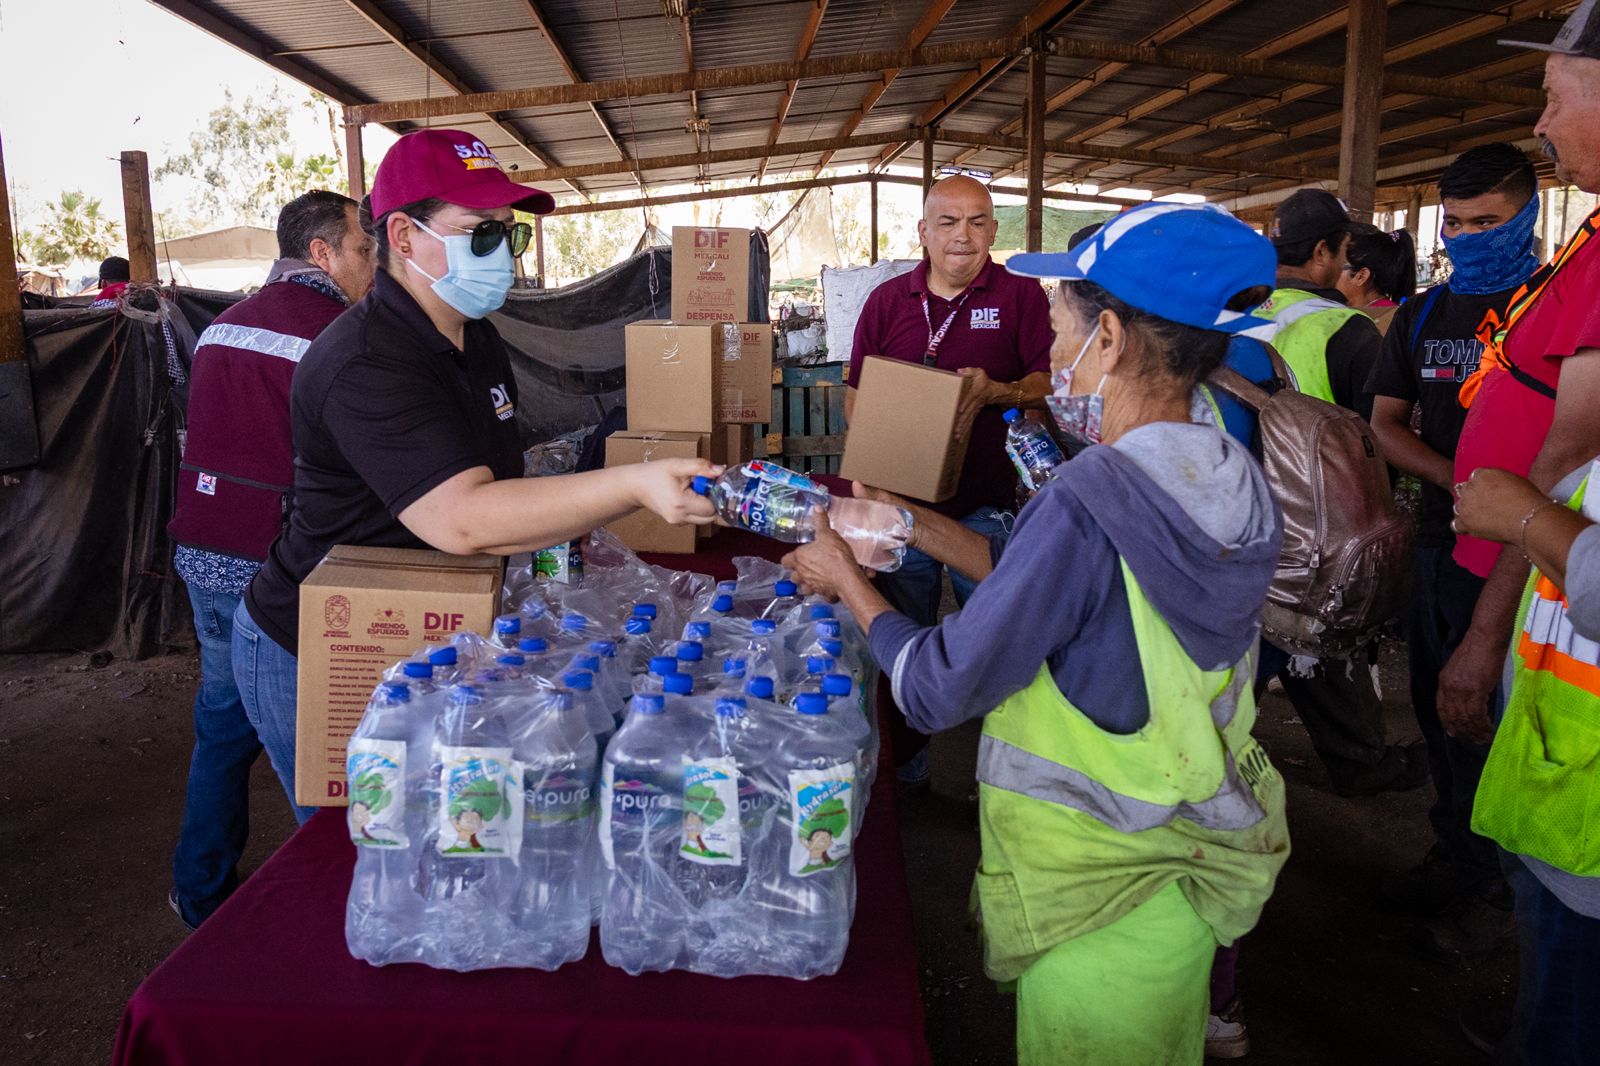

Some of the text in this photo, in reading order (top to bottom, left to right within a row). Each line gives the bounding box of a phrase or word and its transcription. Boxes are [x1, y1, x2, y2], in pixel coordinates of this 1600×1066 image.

[694, 231, 730, 249] DIF
[686, 312, 735, 320] DESPENSA
[971, 308, 1000, 321] DIF
[743, 333, 760, 341] DIF
[423, 612, 464, 631] DIF
[367, 628, 409, 636] ESFUERZOS
[329, 644, 385, 653] CONTENIDO:
